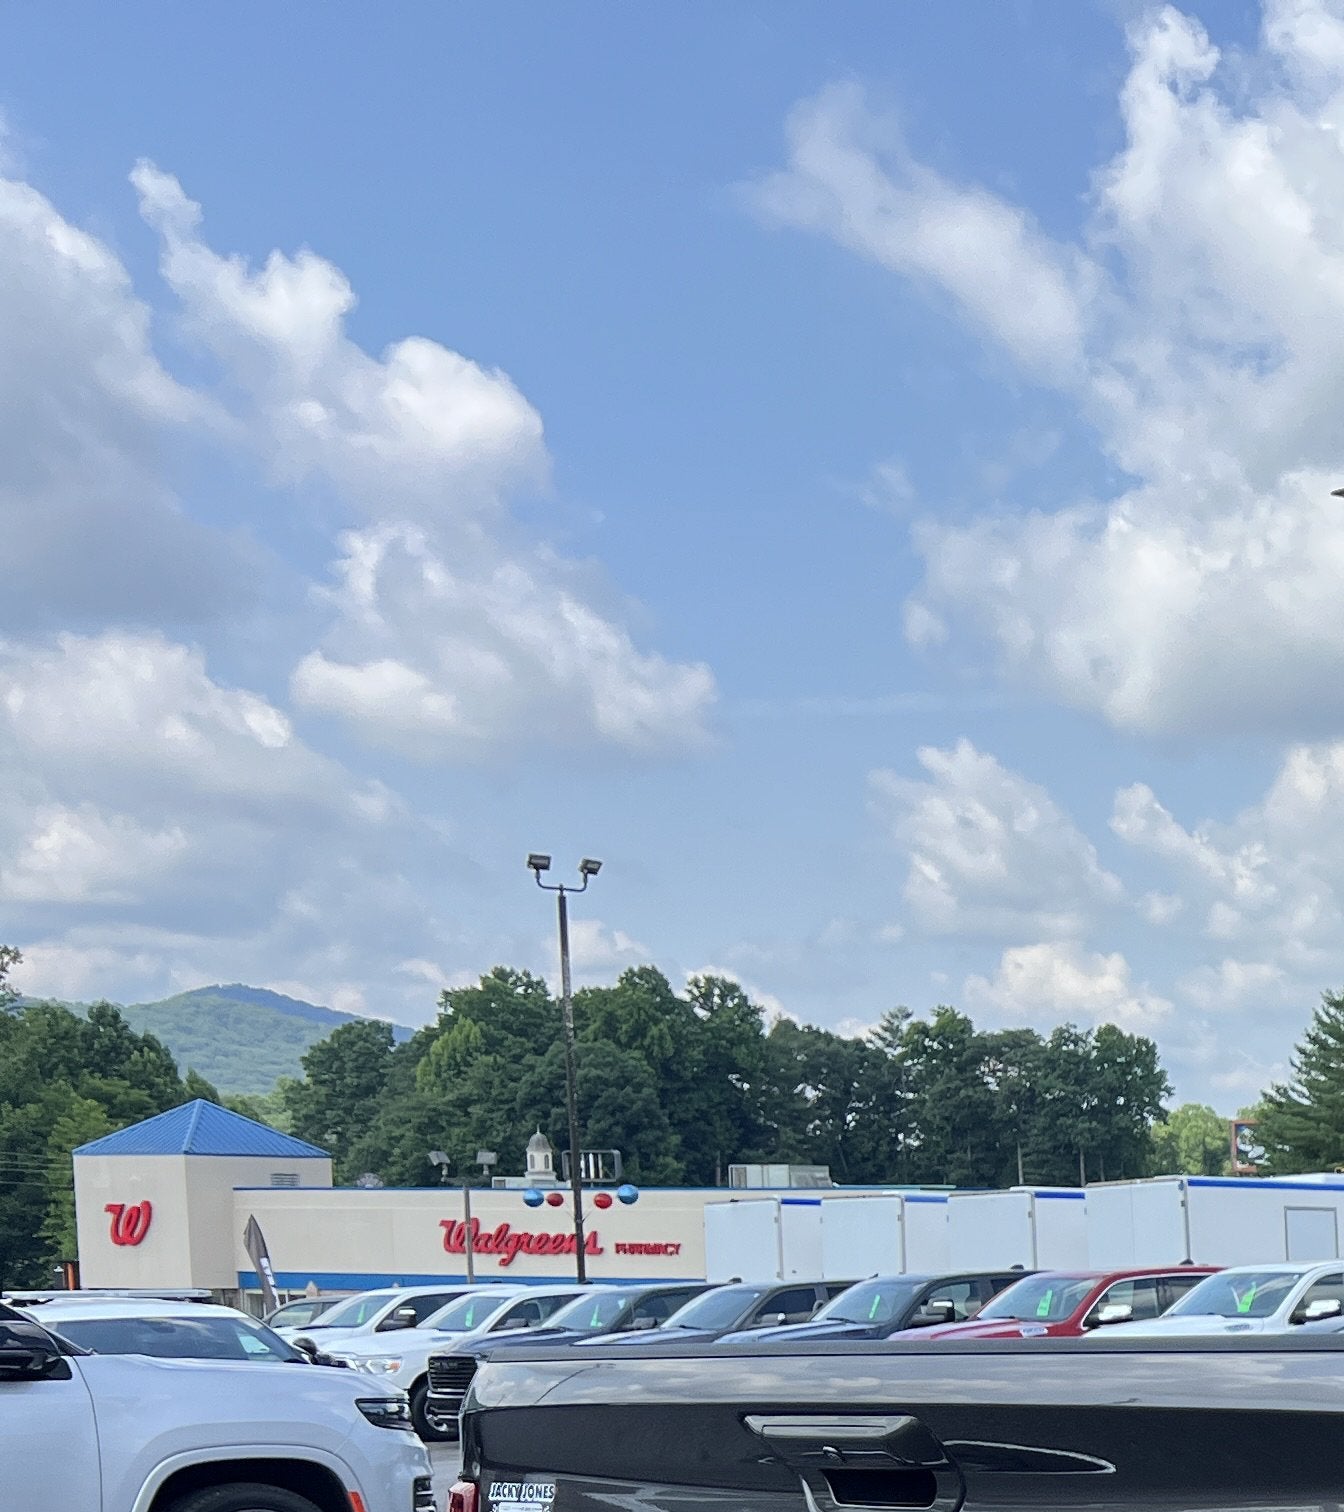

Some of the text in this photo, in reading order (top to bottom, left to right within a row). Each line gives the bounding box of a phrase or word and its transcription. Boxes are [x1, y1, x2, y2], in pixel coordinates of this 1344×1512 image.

[104, 1200, 152, 1246] W
[439, 1217, 603, 1266] Walgreens
[490, 1483, 556, 1501] JACKY JONES
